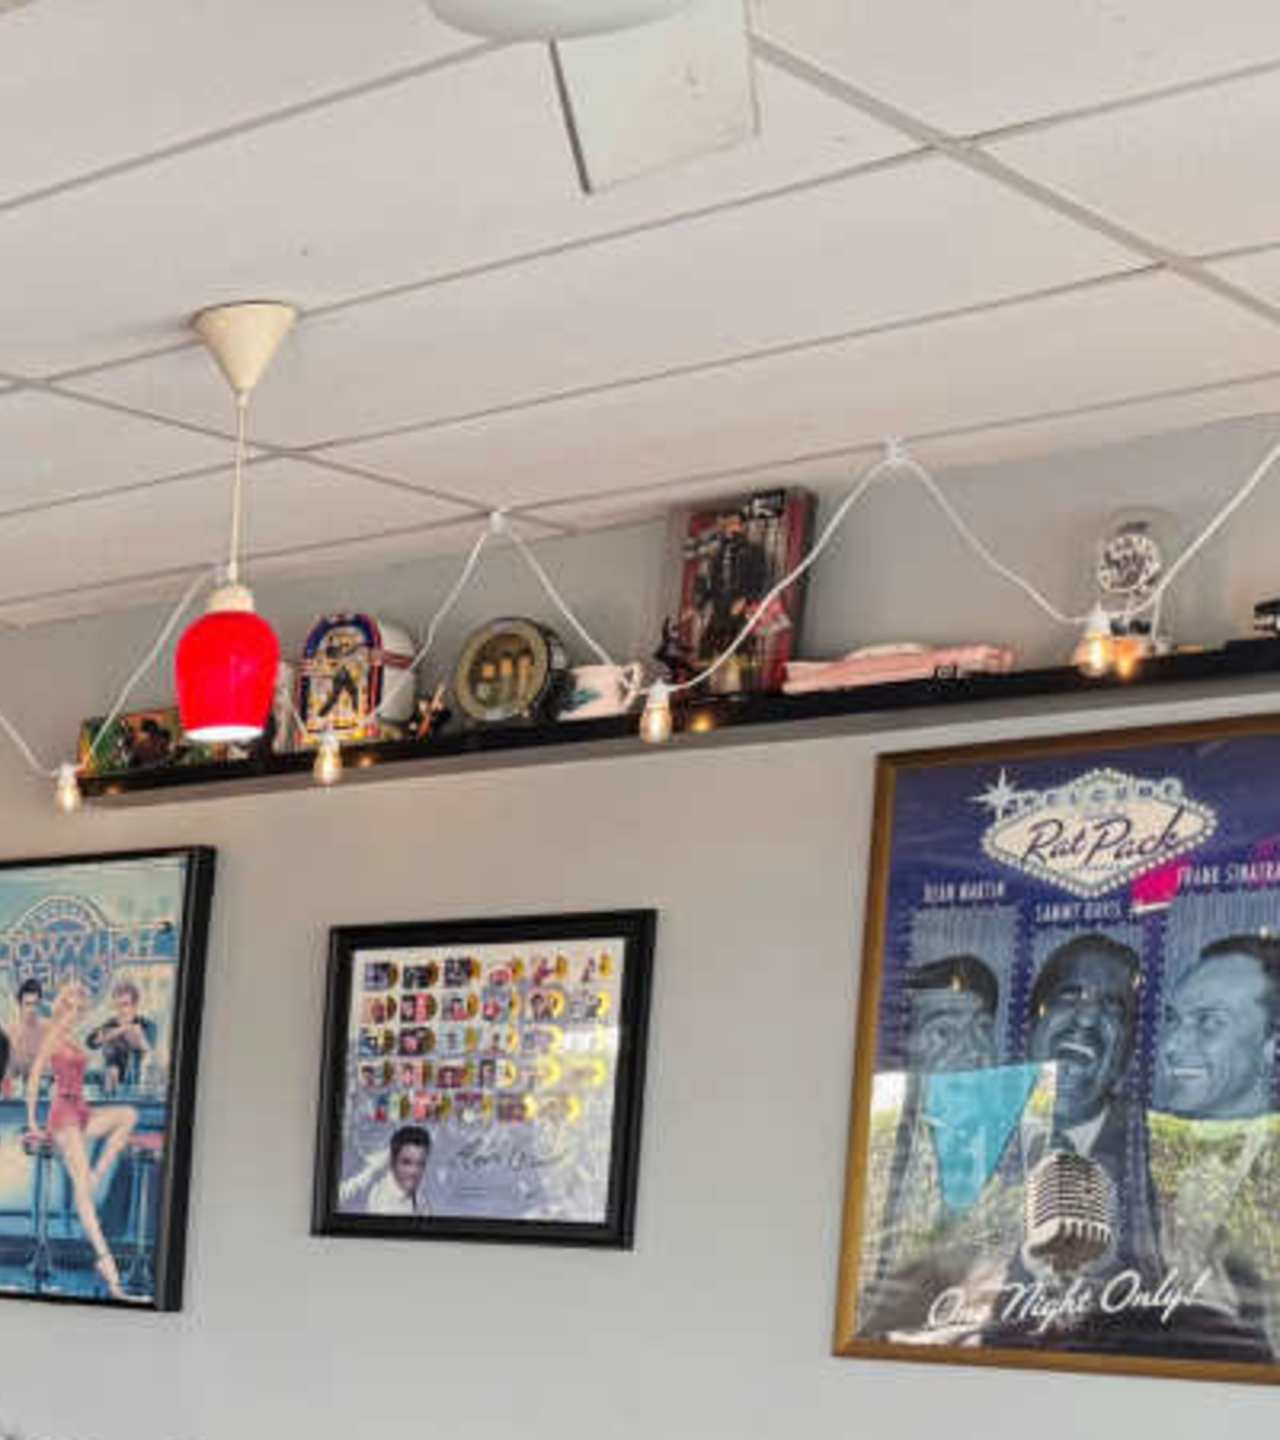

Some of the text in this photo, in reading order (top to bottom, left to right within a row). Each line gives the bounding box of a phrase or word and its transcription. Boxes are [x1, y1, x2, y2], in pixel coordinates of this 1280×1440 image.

[1021, 804, 1180, 866] Rat Pack
[1000, 1276, 1089, 1336] Night
[1099, 1267, 1215, 1324] Only!
